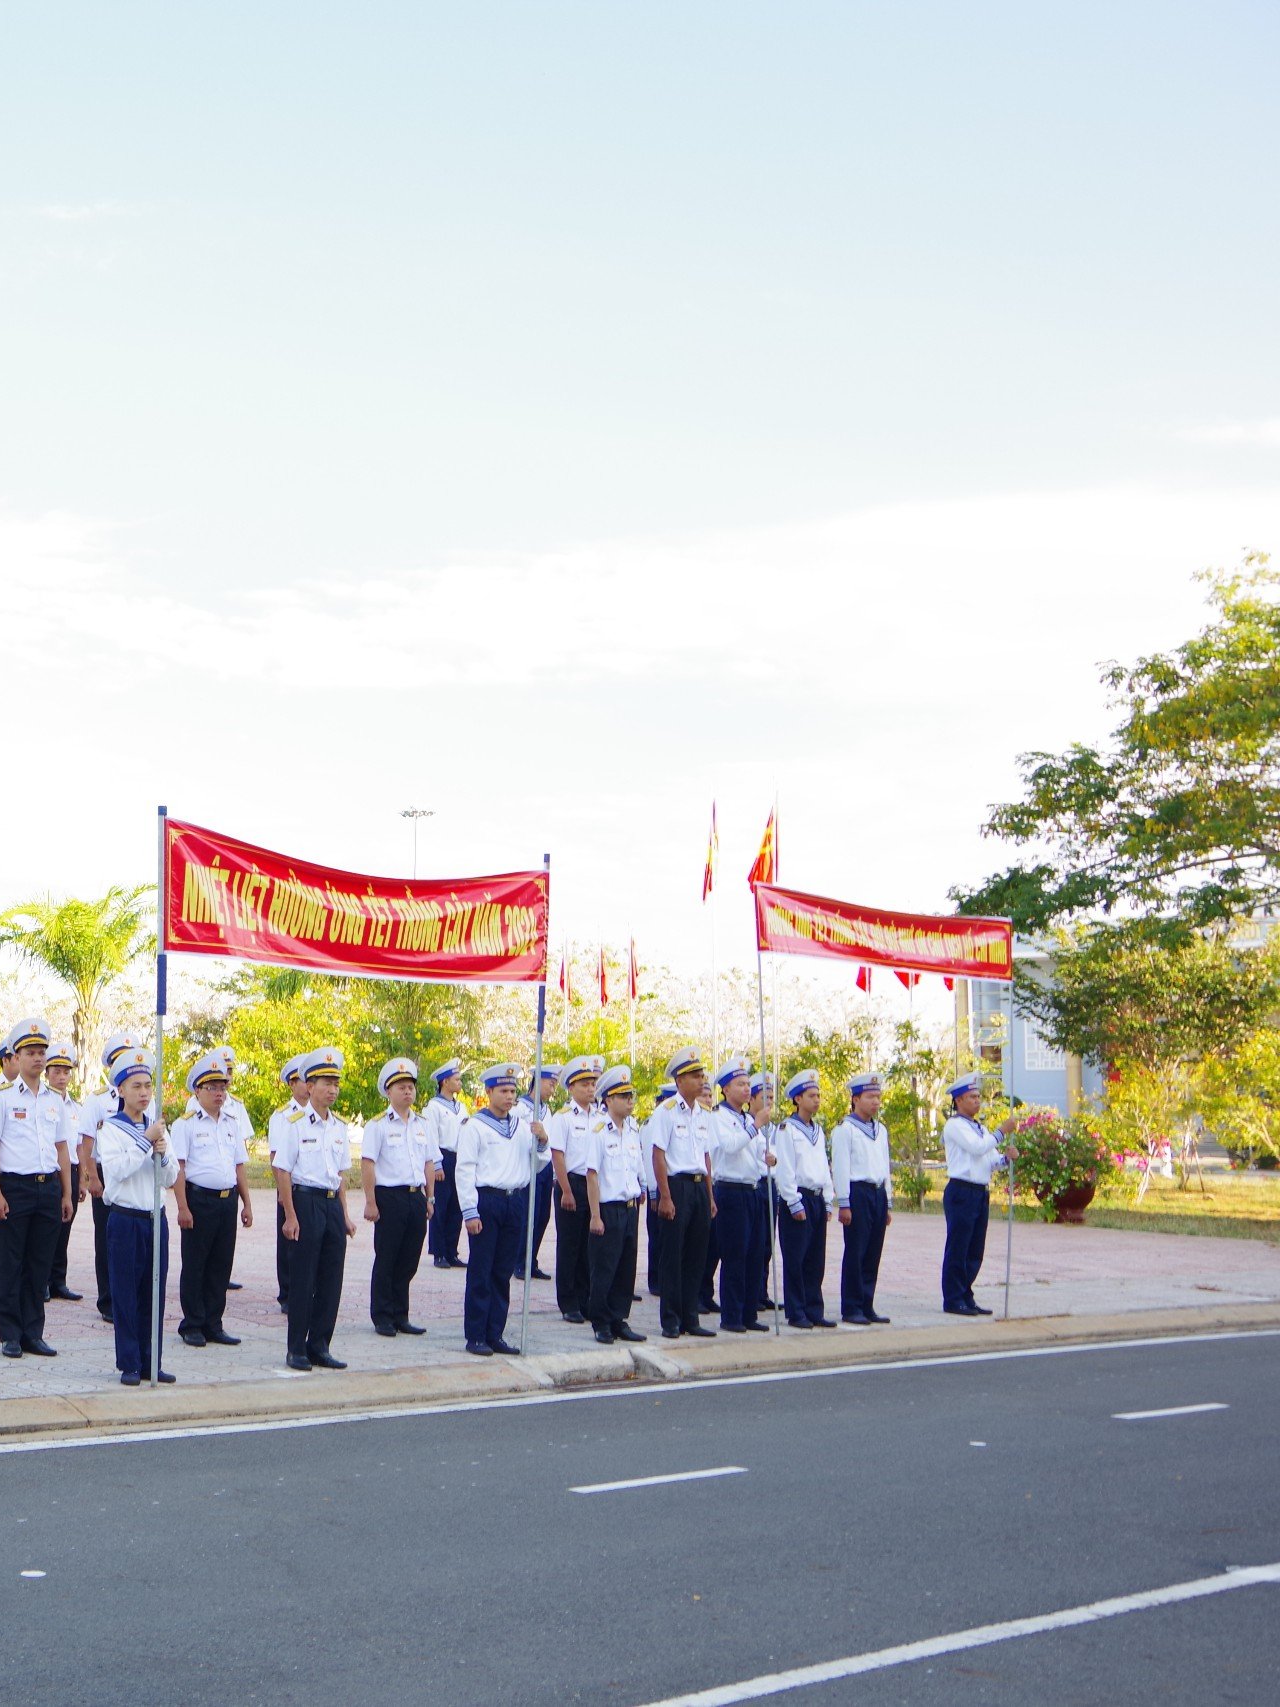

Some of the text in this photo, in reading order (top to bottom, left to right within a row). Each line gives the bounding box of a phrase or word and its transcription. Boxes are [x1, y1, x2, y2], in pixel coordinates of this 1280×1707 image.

[182, 854, 539, 957] NHIỆT LIỆT HƯỞNG ỨNG TẾT TRỒNG CÂY NĂM 2024
